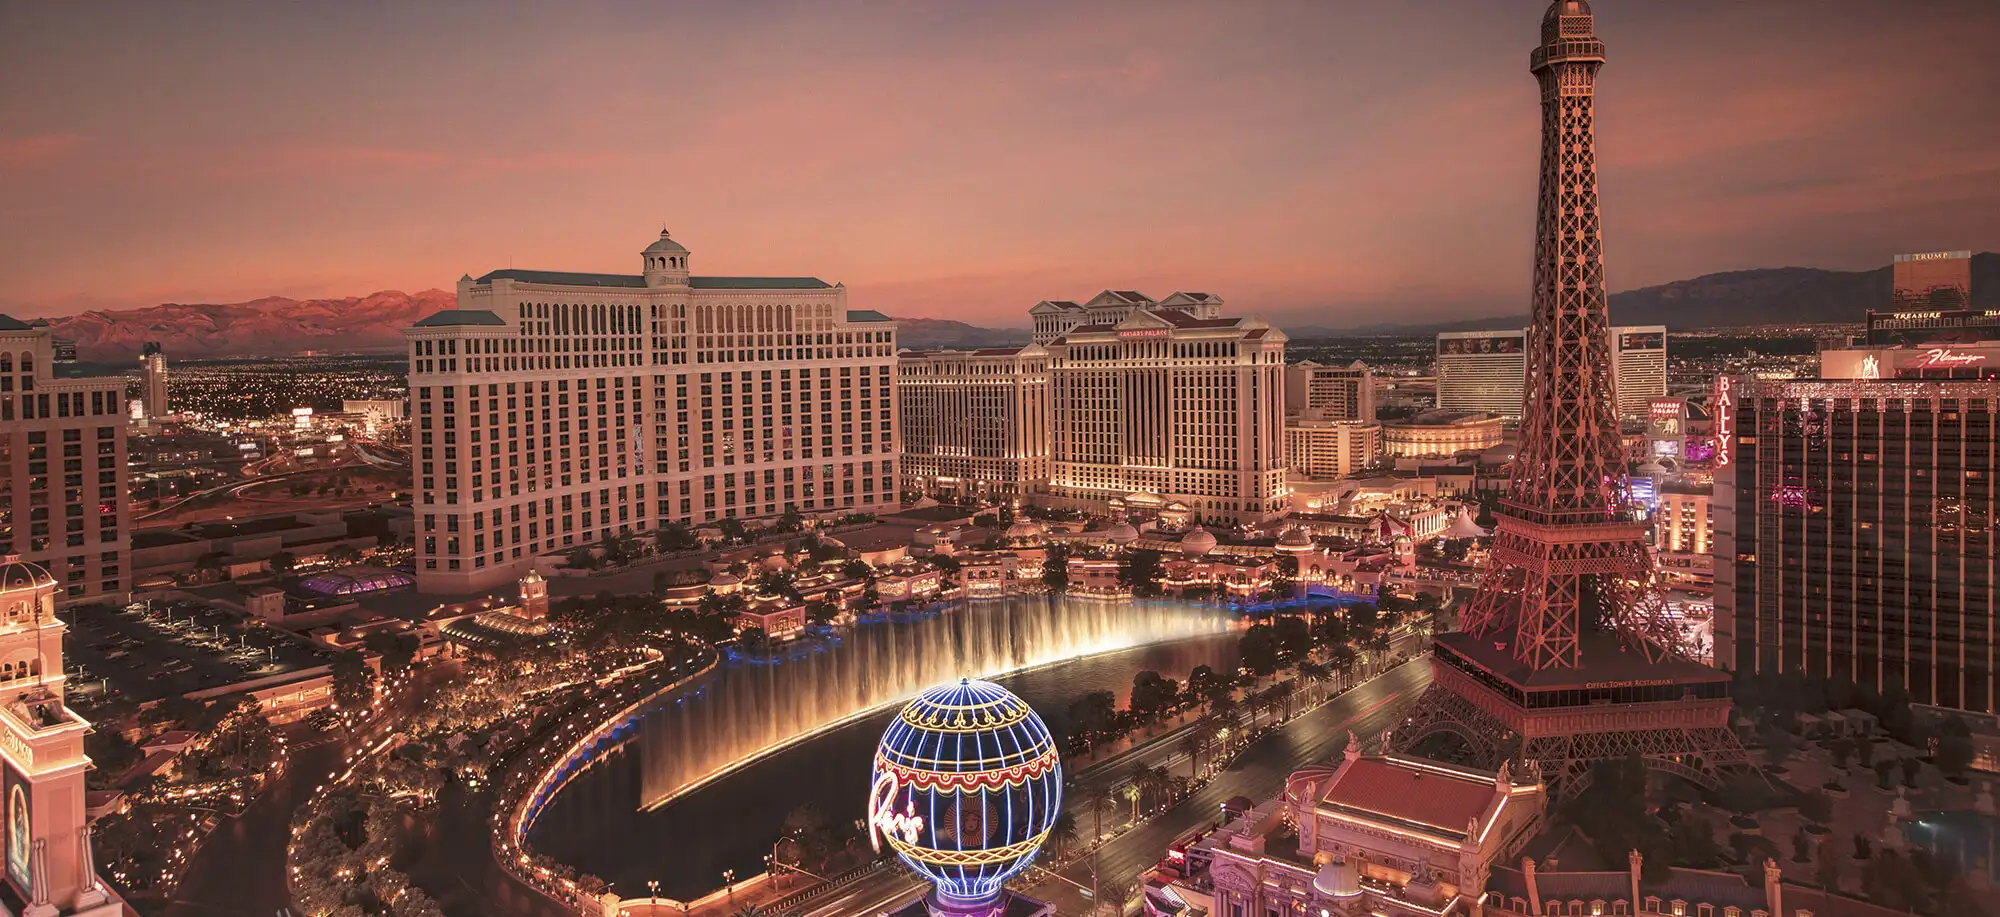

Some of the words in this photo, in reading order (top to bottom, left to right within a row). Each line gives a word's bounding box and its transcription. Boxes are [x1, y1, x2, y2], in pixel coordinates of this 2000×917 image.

[1914, 251, 1948, 260] TRUMP
[1893, 312, 1942, 320] TREASURE
[1927, 348, 1986, 365] Flamingo
[868, 771, 924, 854] Paris
